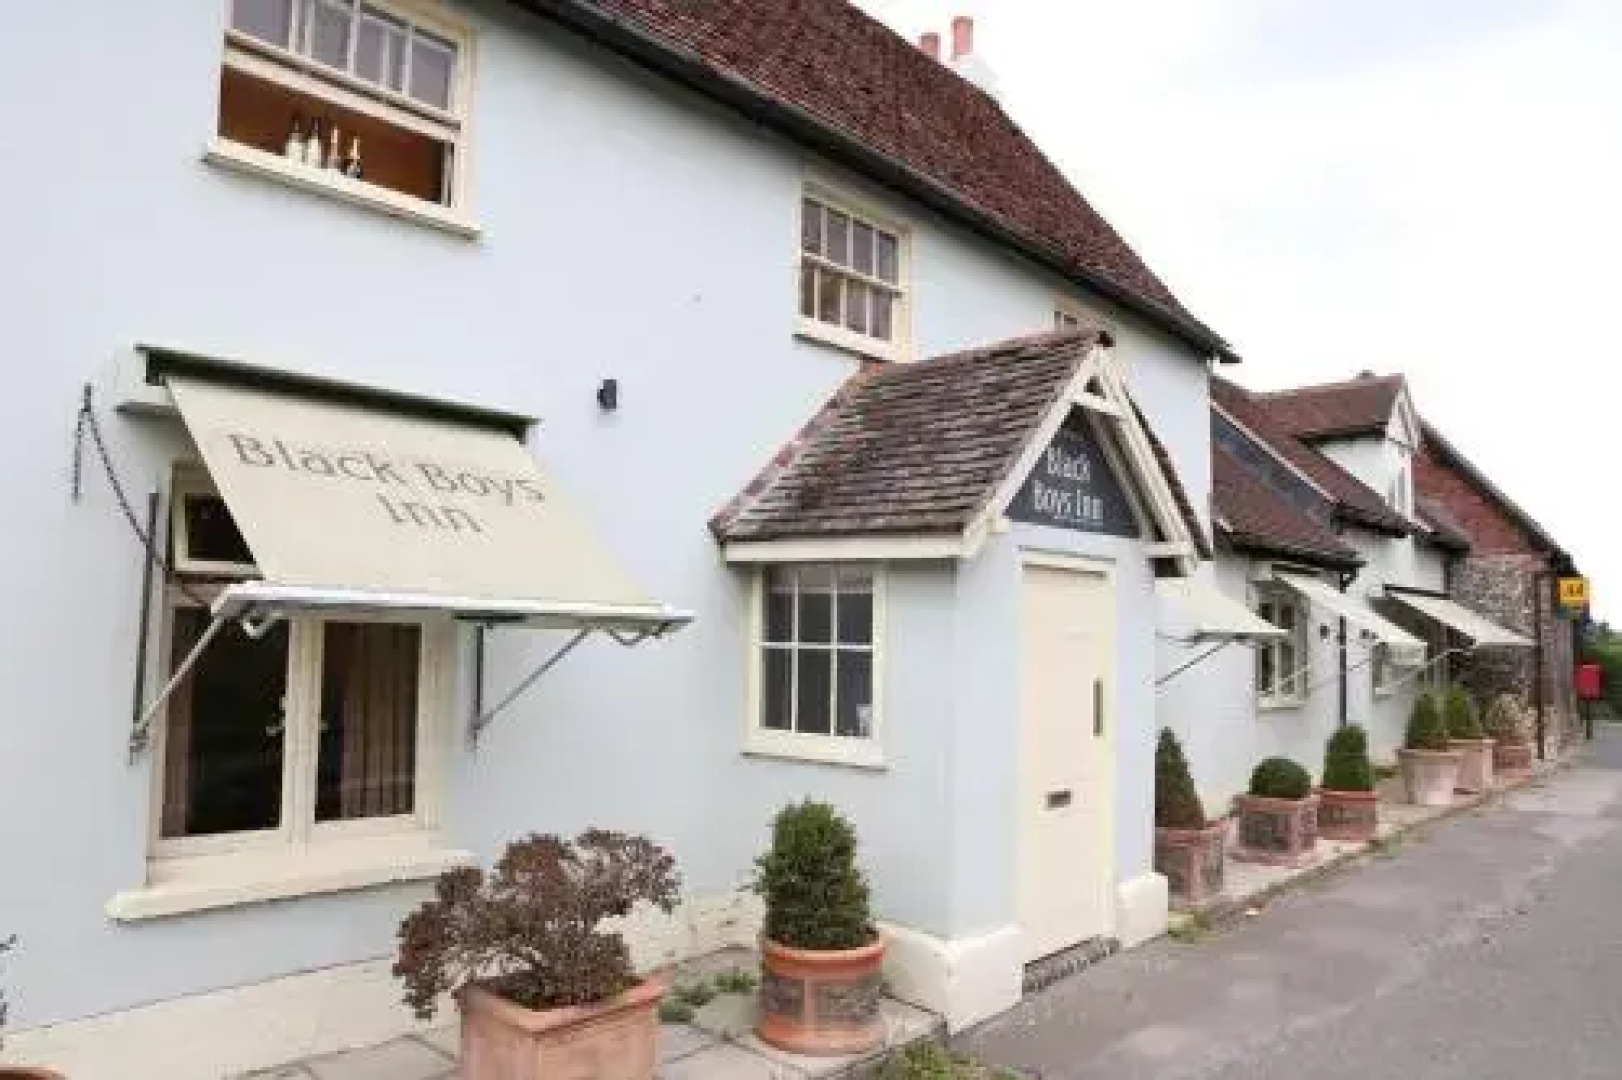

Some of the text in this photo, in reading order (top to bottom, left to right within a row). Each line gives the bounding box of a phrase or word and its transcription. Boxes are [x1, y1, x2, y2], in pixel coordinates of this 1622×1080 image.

[227, 433, 547, 506] Black Boys
[375, 492, 484, 533] Inn
